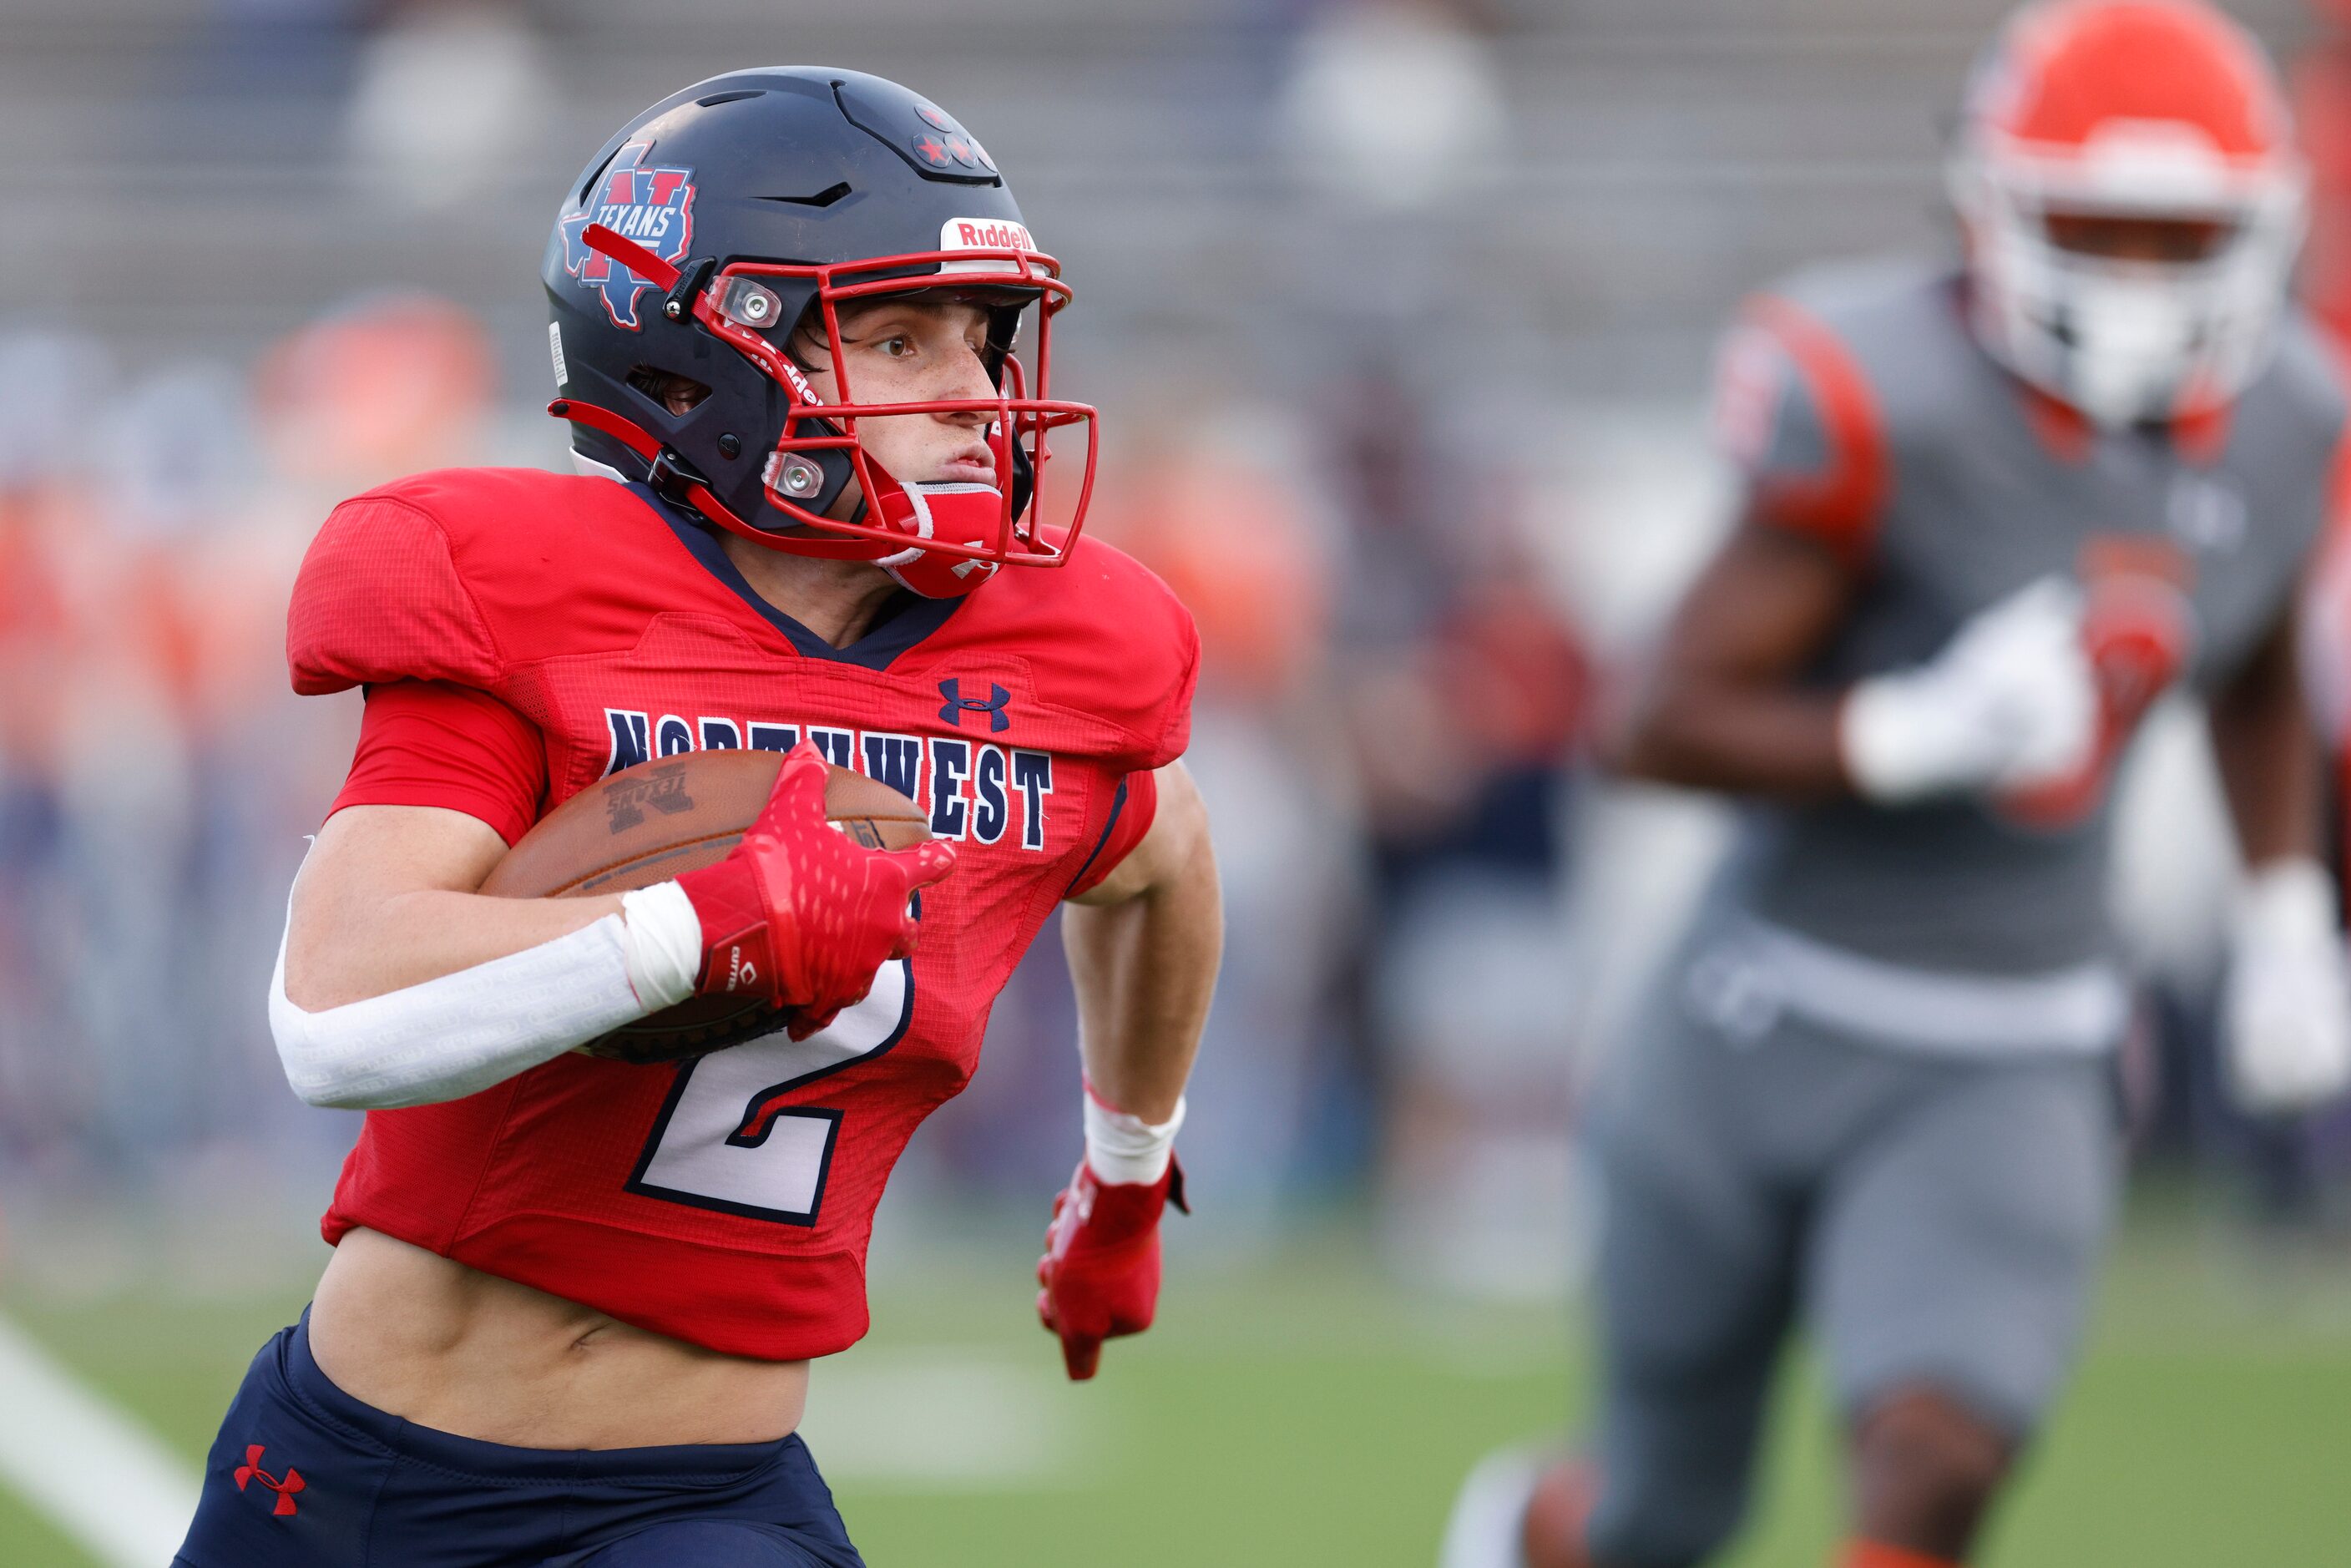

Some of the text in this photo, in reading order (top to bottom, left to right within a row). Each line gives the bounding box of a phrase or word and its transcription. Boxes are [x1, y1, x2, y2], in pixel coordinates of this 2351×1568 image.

[594, 204, 677, 238] TEXANS
[957, 223, 1032, 250] Riddell
[606, 772, 687, 816] TEXANS
[623, 891, 921, 1228] 2
